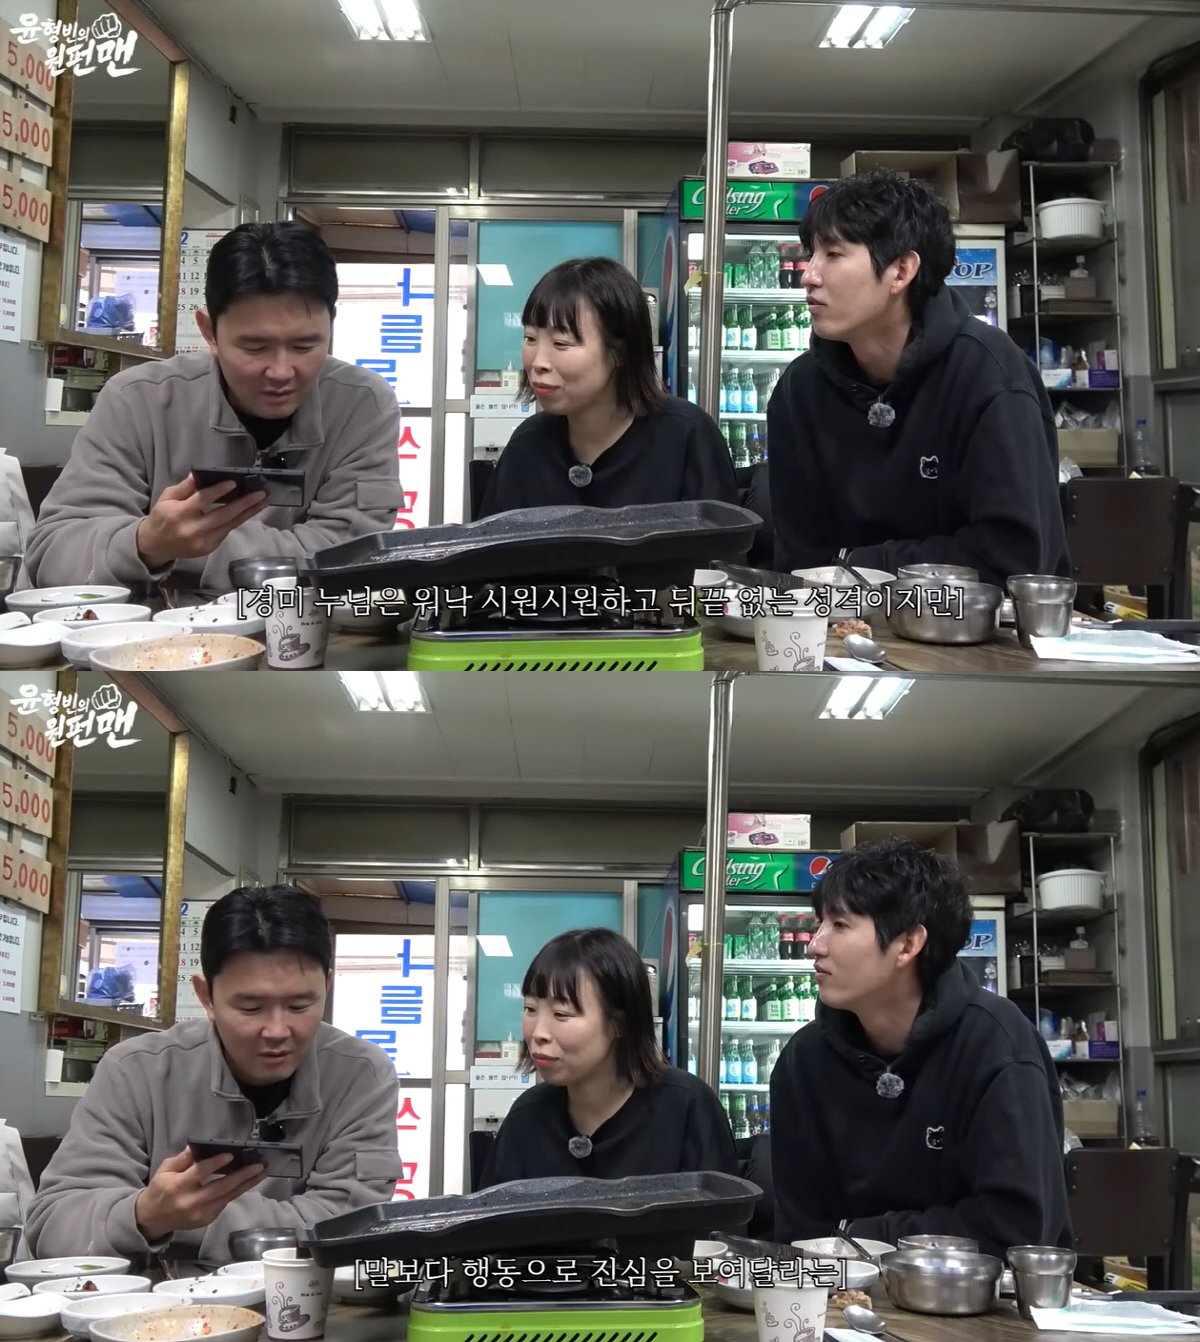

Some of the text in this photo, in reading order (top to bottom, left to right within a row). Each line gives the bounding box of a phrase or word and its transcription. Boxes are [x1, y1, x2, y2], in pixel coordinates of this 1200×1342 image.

[2, 112, 50, 153] 5,000
[2, 184, 49, 227] 5,000
[2, 783, 50, 824] 5,000
[2, 855, 49, 898] 5,000
